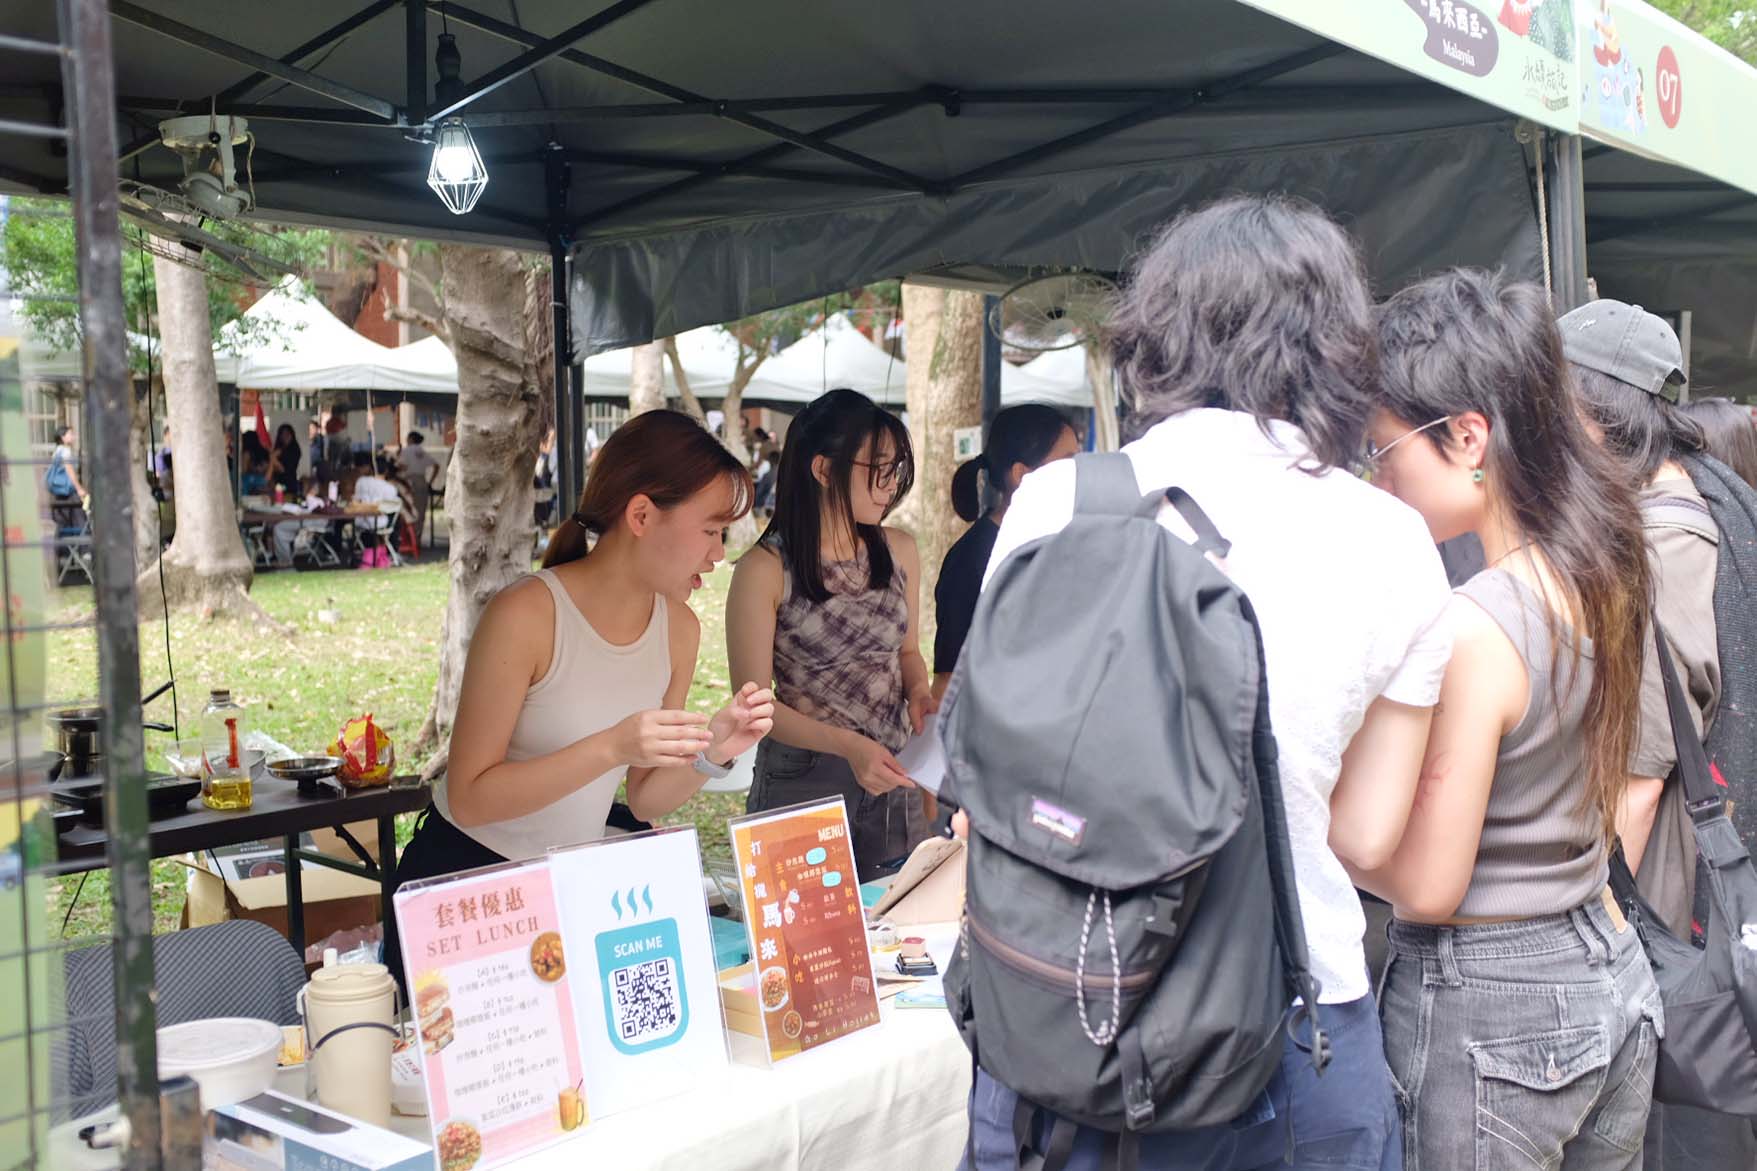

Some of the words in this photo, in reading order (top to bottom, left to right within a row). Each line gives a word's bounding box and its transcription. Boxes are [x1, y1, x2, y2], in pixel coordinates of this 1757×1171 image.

[1442, 38, 1476, 67] Malaysia
[1658, 70, 1679, 116] 07
[818, 823, 845, 844] MENU
[434, 885, 526, 930] 套餐優惠
[426, 935, 463, 959] SET
[476, 915, 540, 946] LUNCH
[613, 938, 644, 959] SCAN
[646, 935, 664, 952] ME
